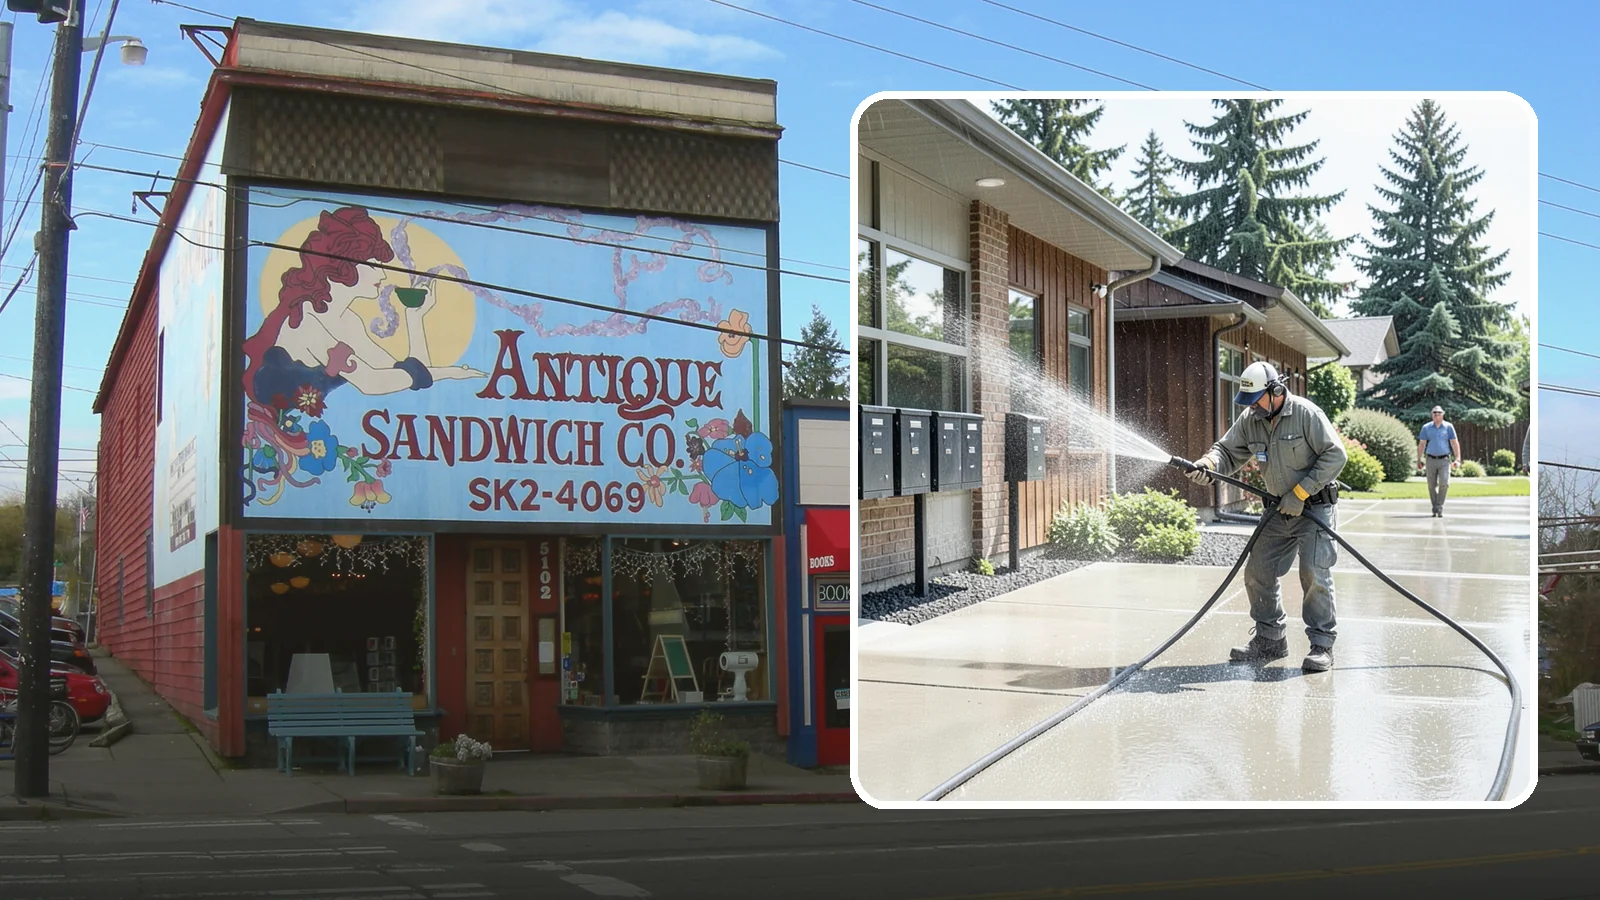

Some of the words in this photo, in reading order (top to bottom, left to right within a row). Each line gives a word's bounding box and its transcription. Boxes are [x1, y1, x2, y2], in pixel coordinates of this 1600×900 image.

[475, 329, 724, 420] ANTIQUE
[361, 408, 605, 467] SANDWICH
[617, 422, 684, 469] CO.
[468, 477, 645, 513] SK2-4069
[539, 542, 552, 600] 5102
[809, 555, 835, 569] BOOKS
